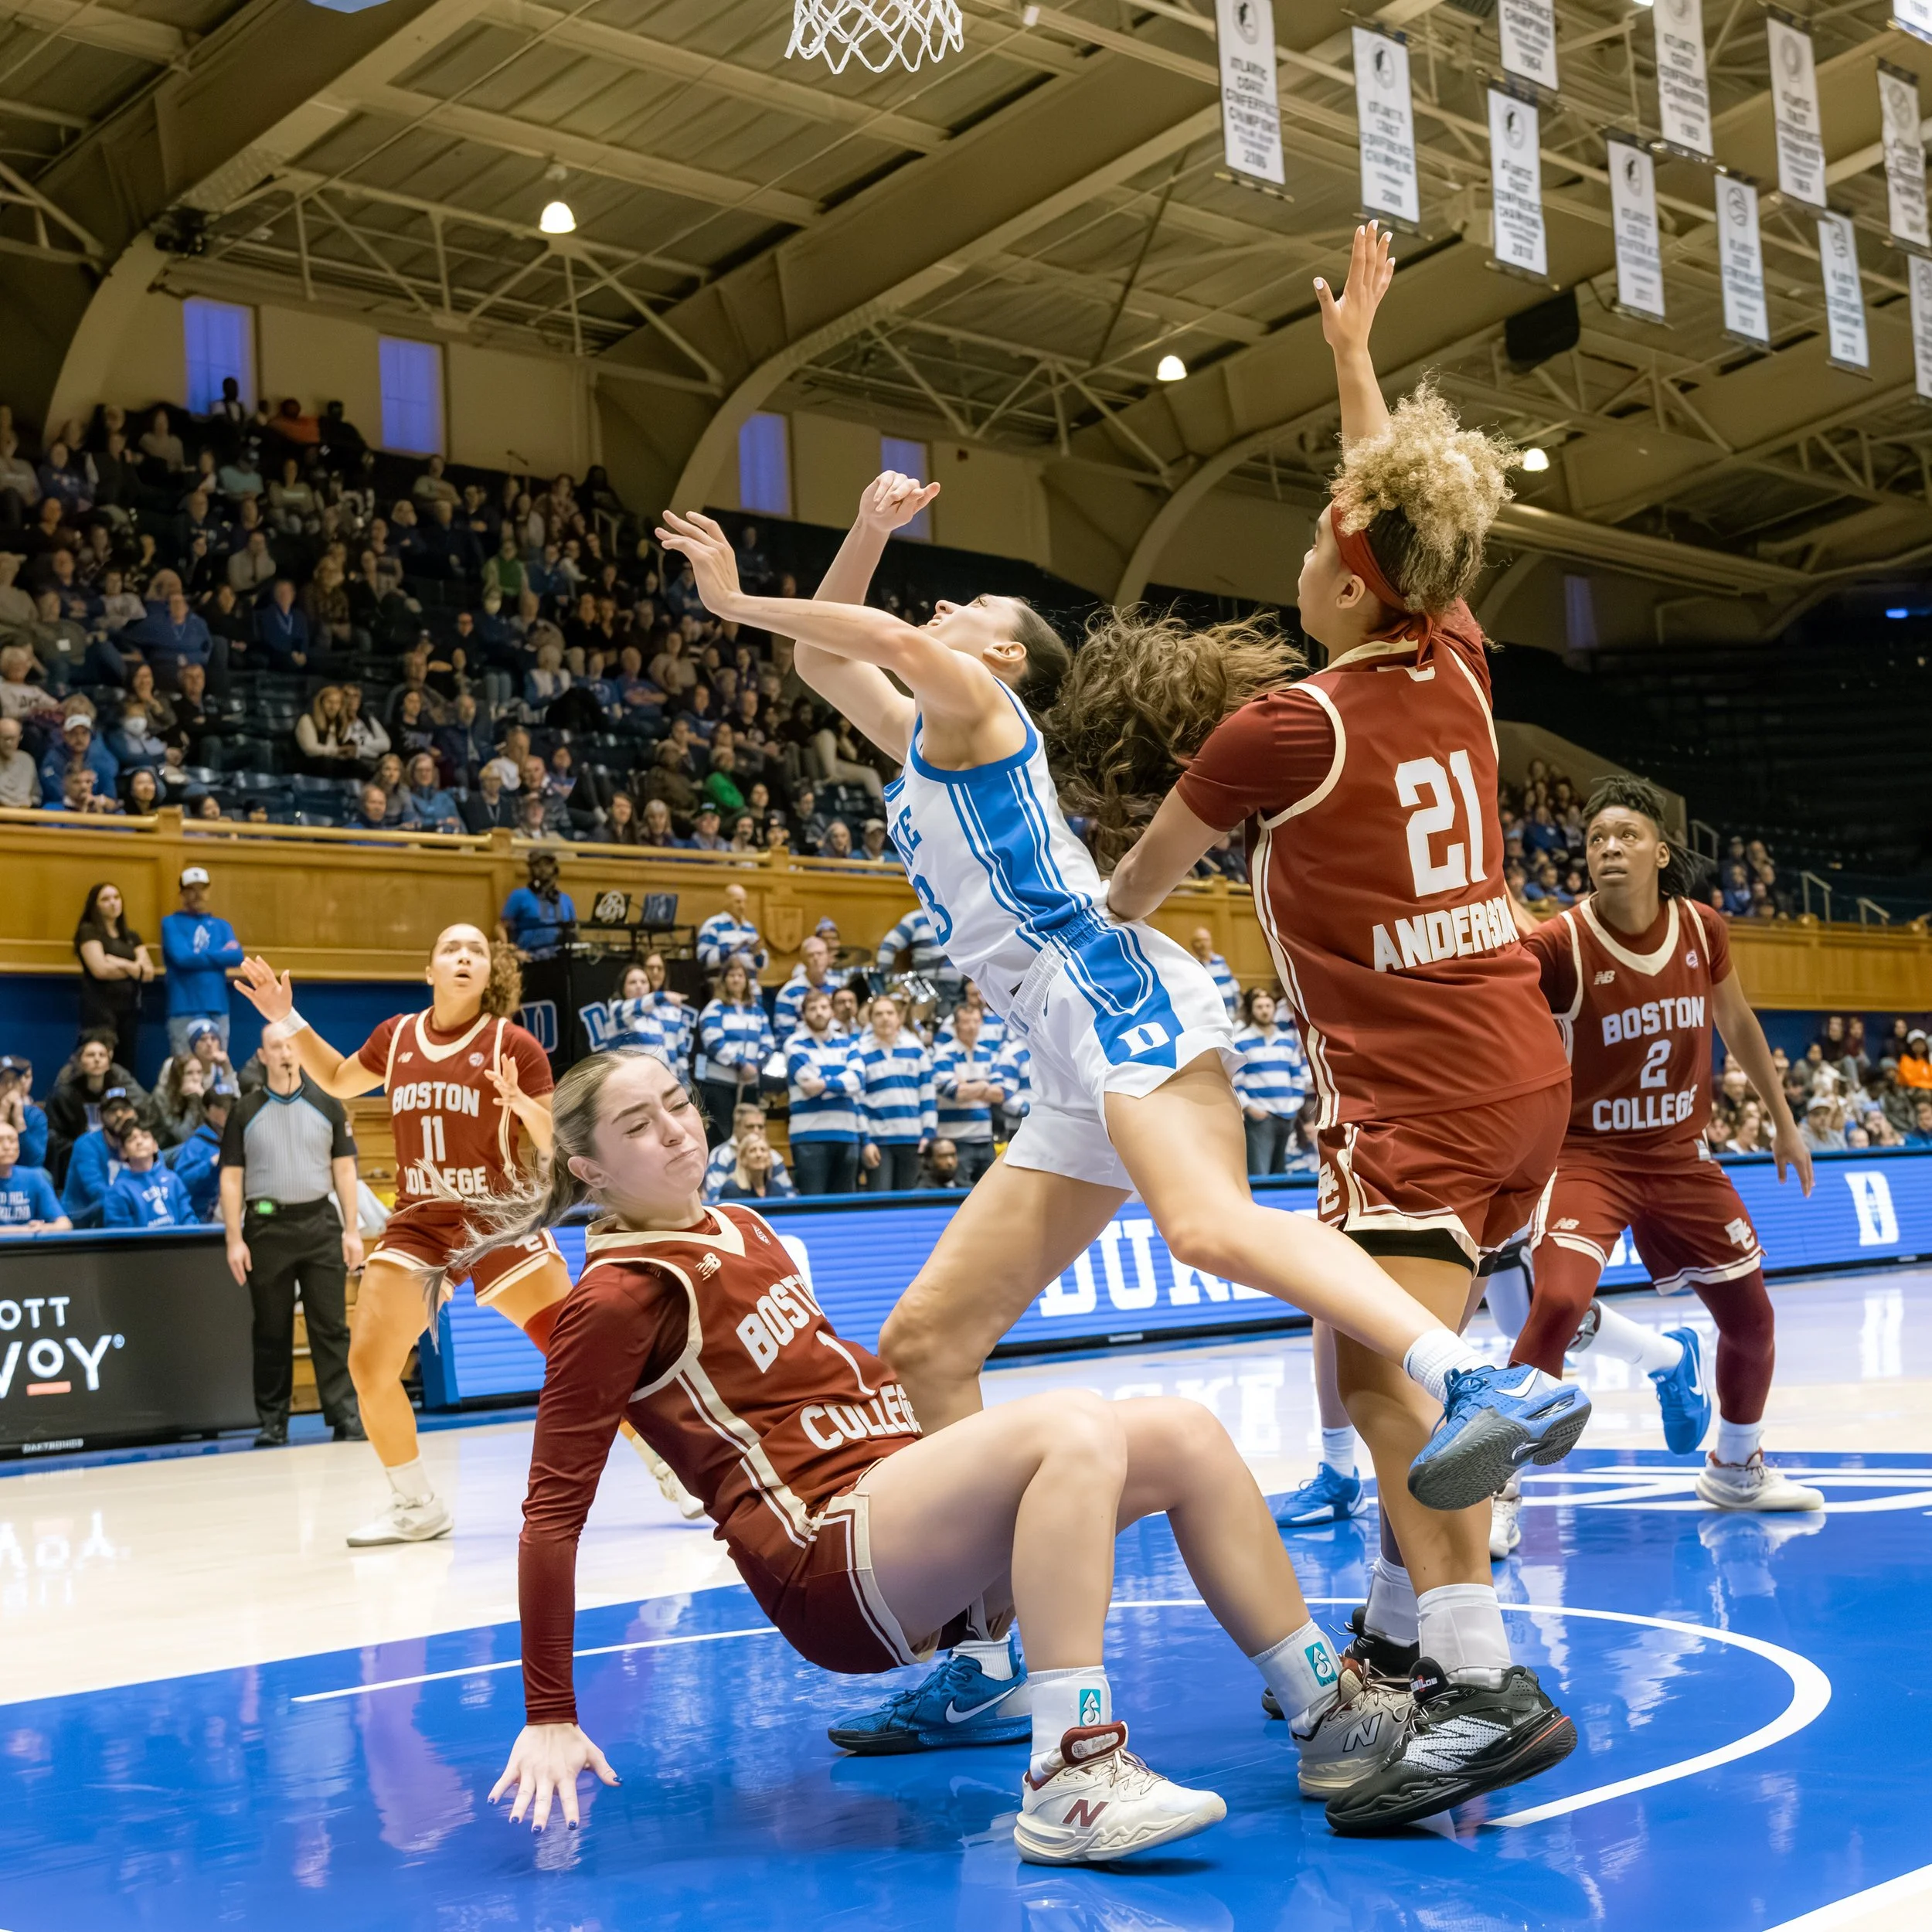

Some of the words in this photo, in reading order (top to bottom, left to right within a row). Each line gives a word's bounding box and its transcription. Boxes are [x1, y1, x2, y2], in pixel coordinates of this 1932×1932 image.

[890, 804, 923, 877] KE
[1395, 750, 1488, 897] 21
[1372, 893, 1520, 972] ANDERSON
[1601, 996, 1705, 1046] BOSTON
[1641, 1039, 1672, 1089] 2
[392, 1081, 480, 1117] BOSTON
[1592, 1084, 1698, 1131] COLLEGE
[420, 1115, 446, 1162] 11
[1039, 1219, 1274, 1318] DUK
[736, 1274, 825, 1374] BOST
[815, 1330, 876, 1396] 1
